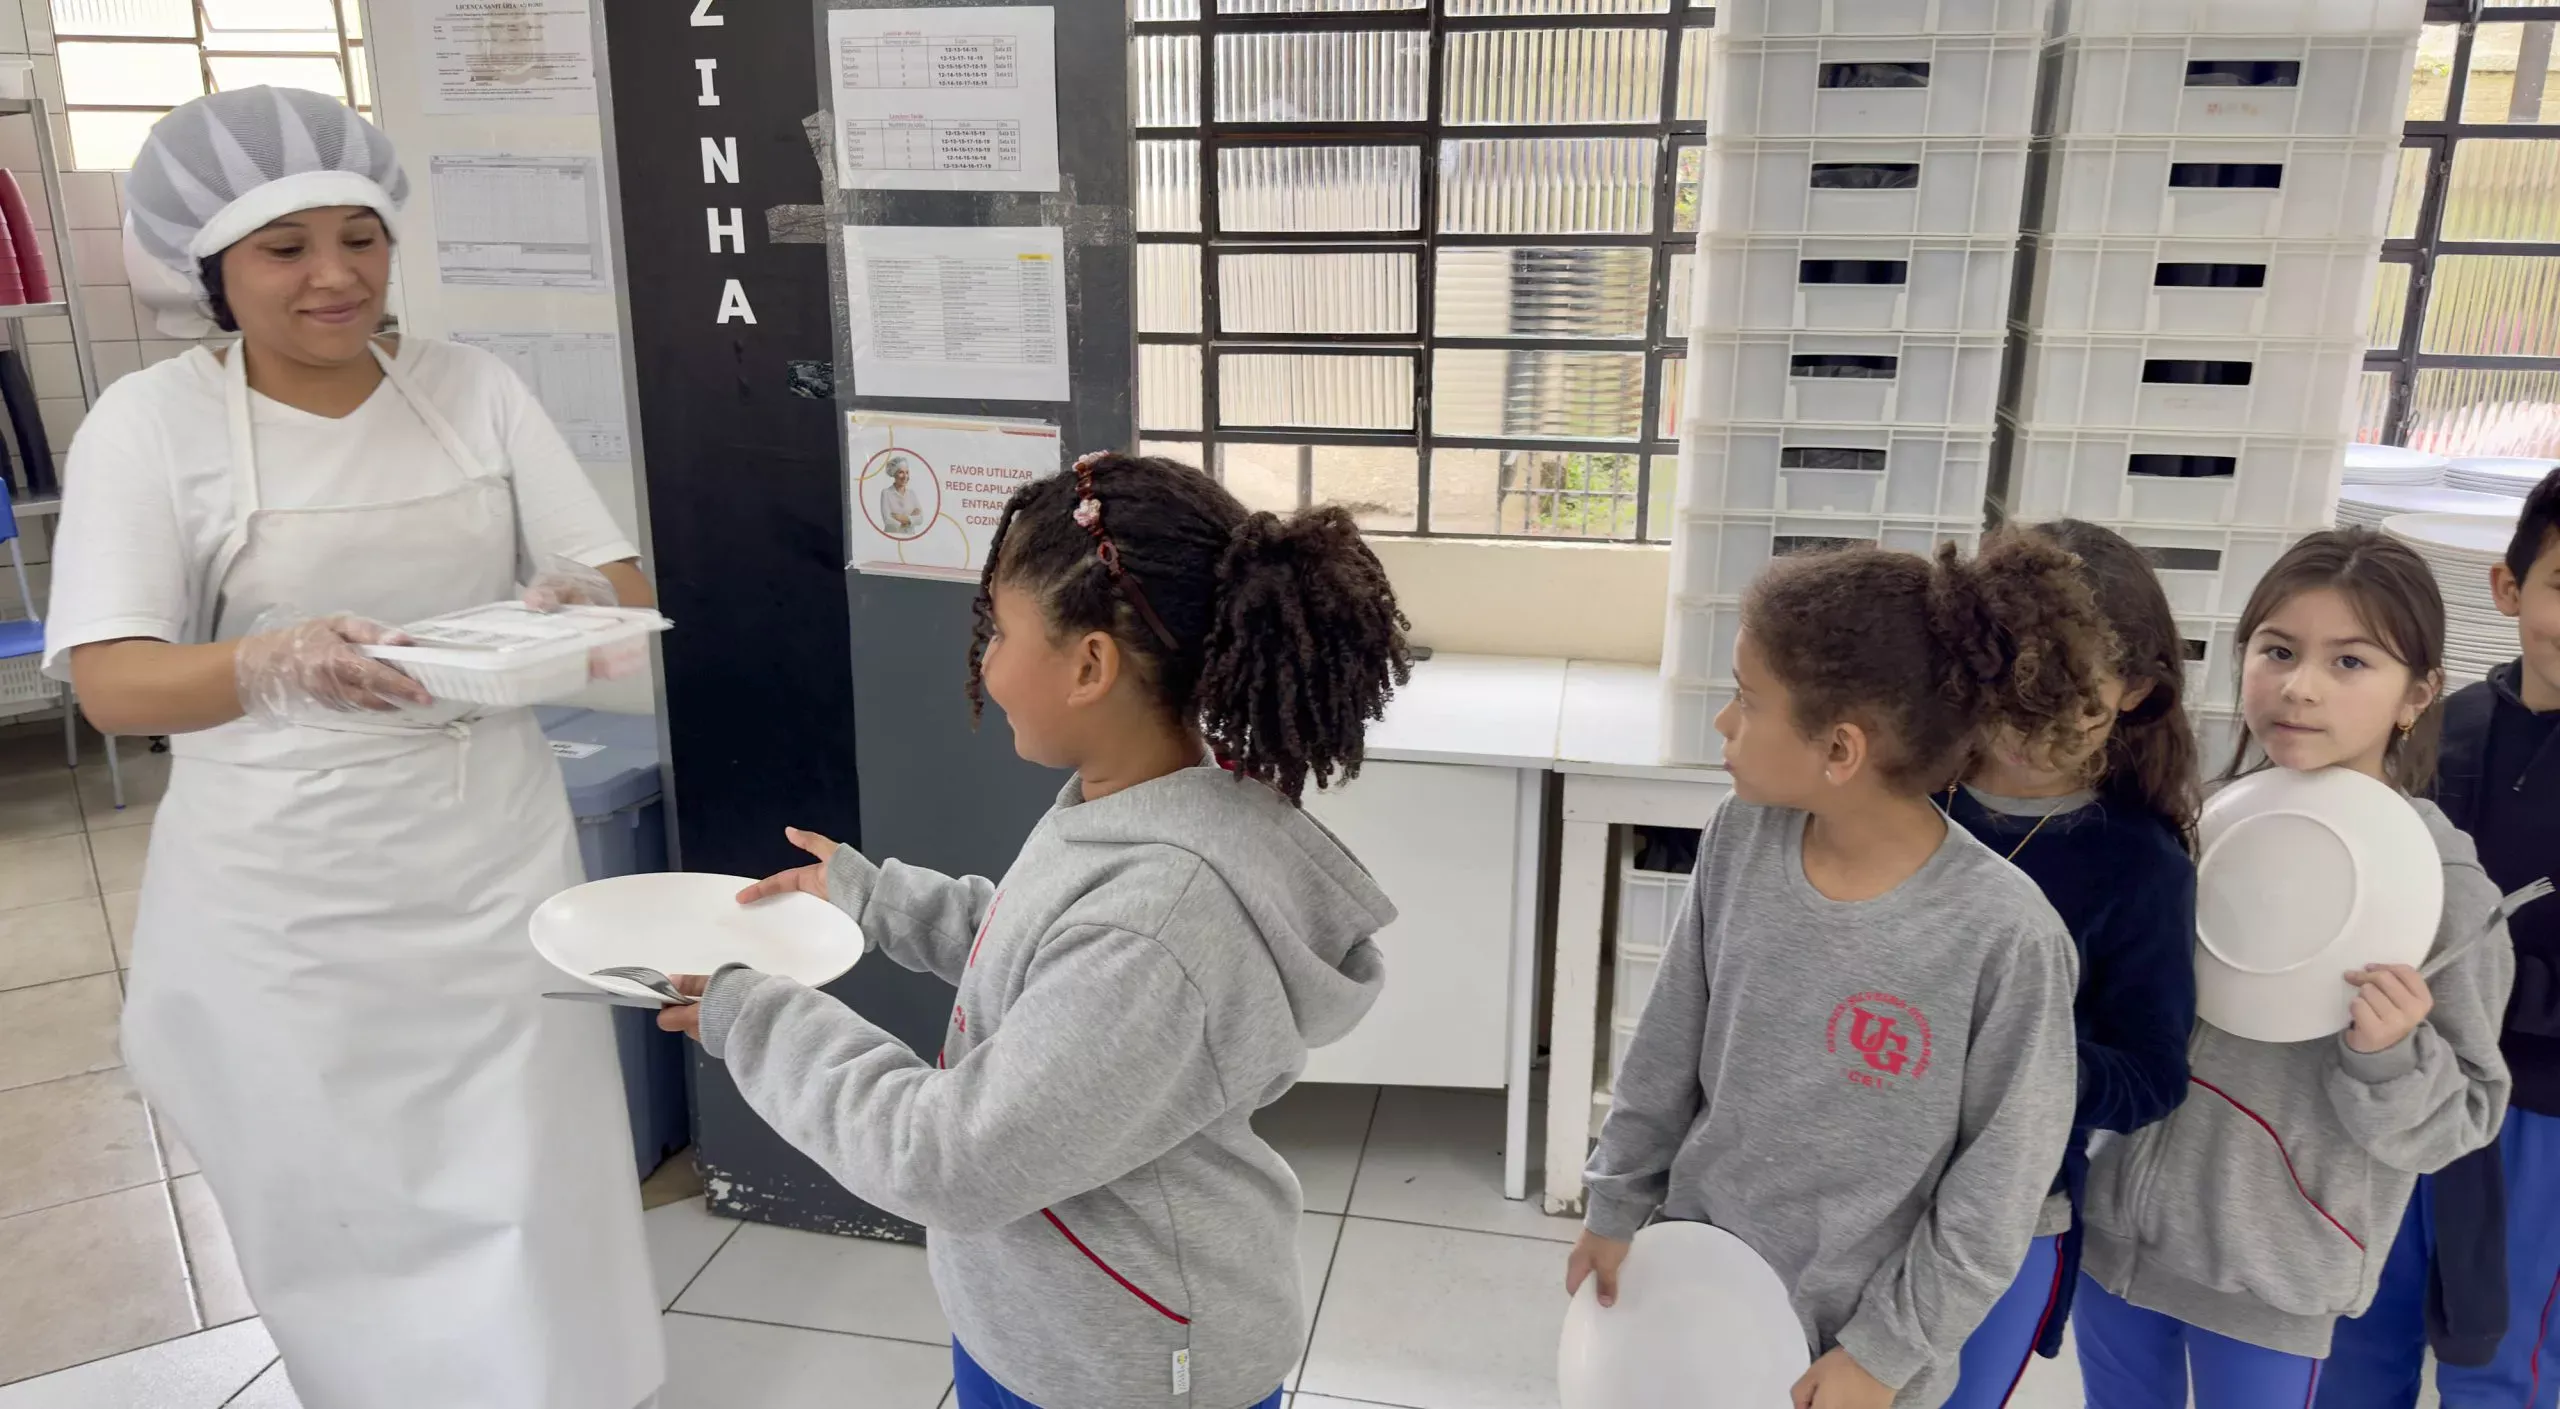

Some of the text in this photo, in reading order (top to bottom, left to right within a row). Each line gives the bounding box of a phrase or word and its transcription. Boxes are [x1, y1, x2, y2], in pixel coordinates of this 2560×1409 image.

[949, 464, 1034, 480] FAVOR UTILIZAR
[945, 480, 973, 492] REDE
[961, 498, 1004, 510] ENTRAR
[966, 515, 1001, 526] COZIN
